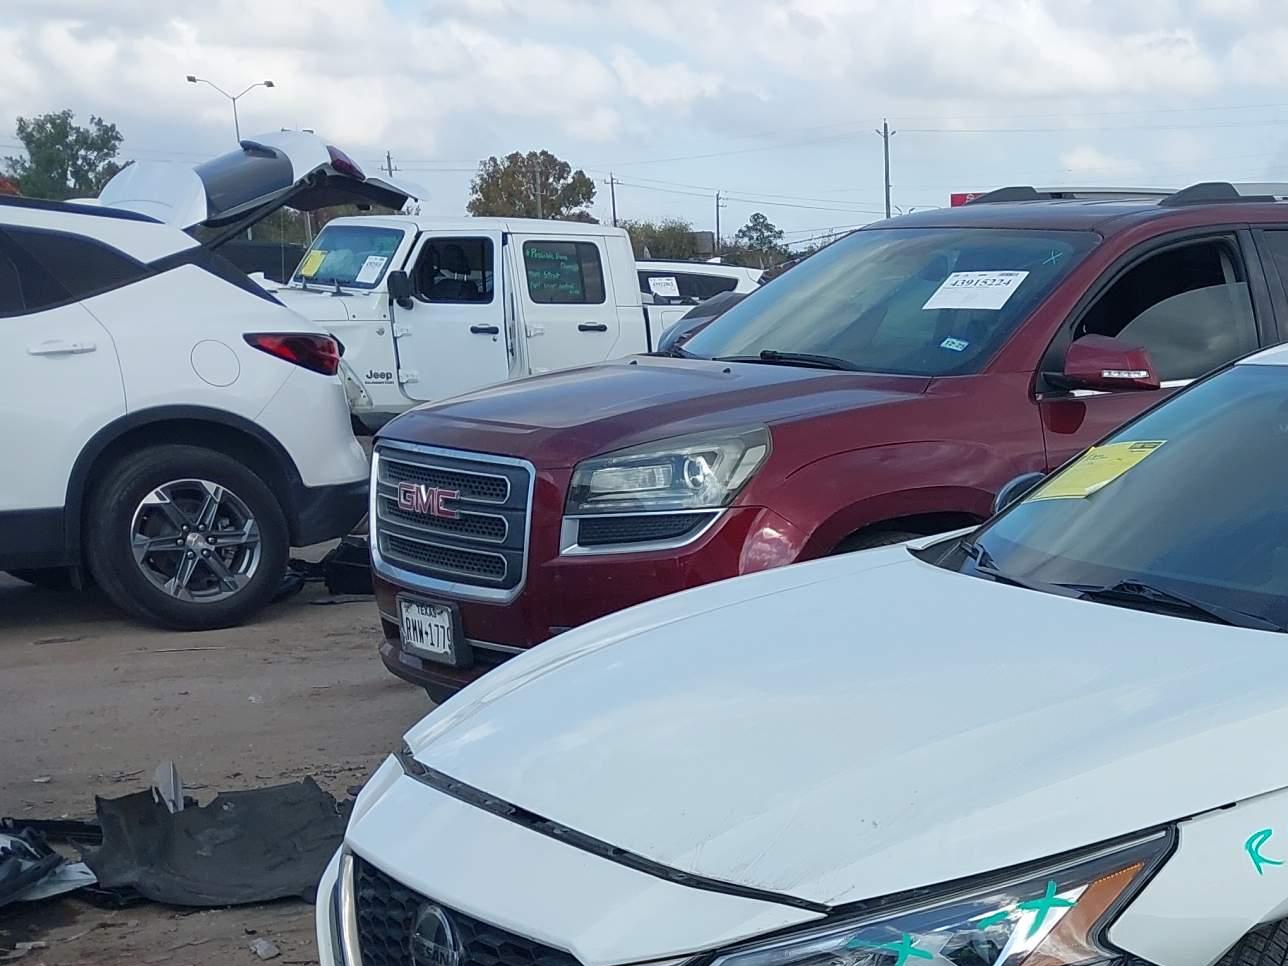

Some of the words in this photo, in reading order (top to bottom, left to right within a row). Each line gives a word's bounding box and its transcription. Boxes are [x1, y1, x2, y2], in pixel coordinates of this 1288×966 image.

[950, 278, 1012, 287] 43915224
[365, 369, 393, 381] Jeep
[398, 481, 460, 519] GMC
[416, 604, 438, 618] TEXAS
